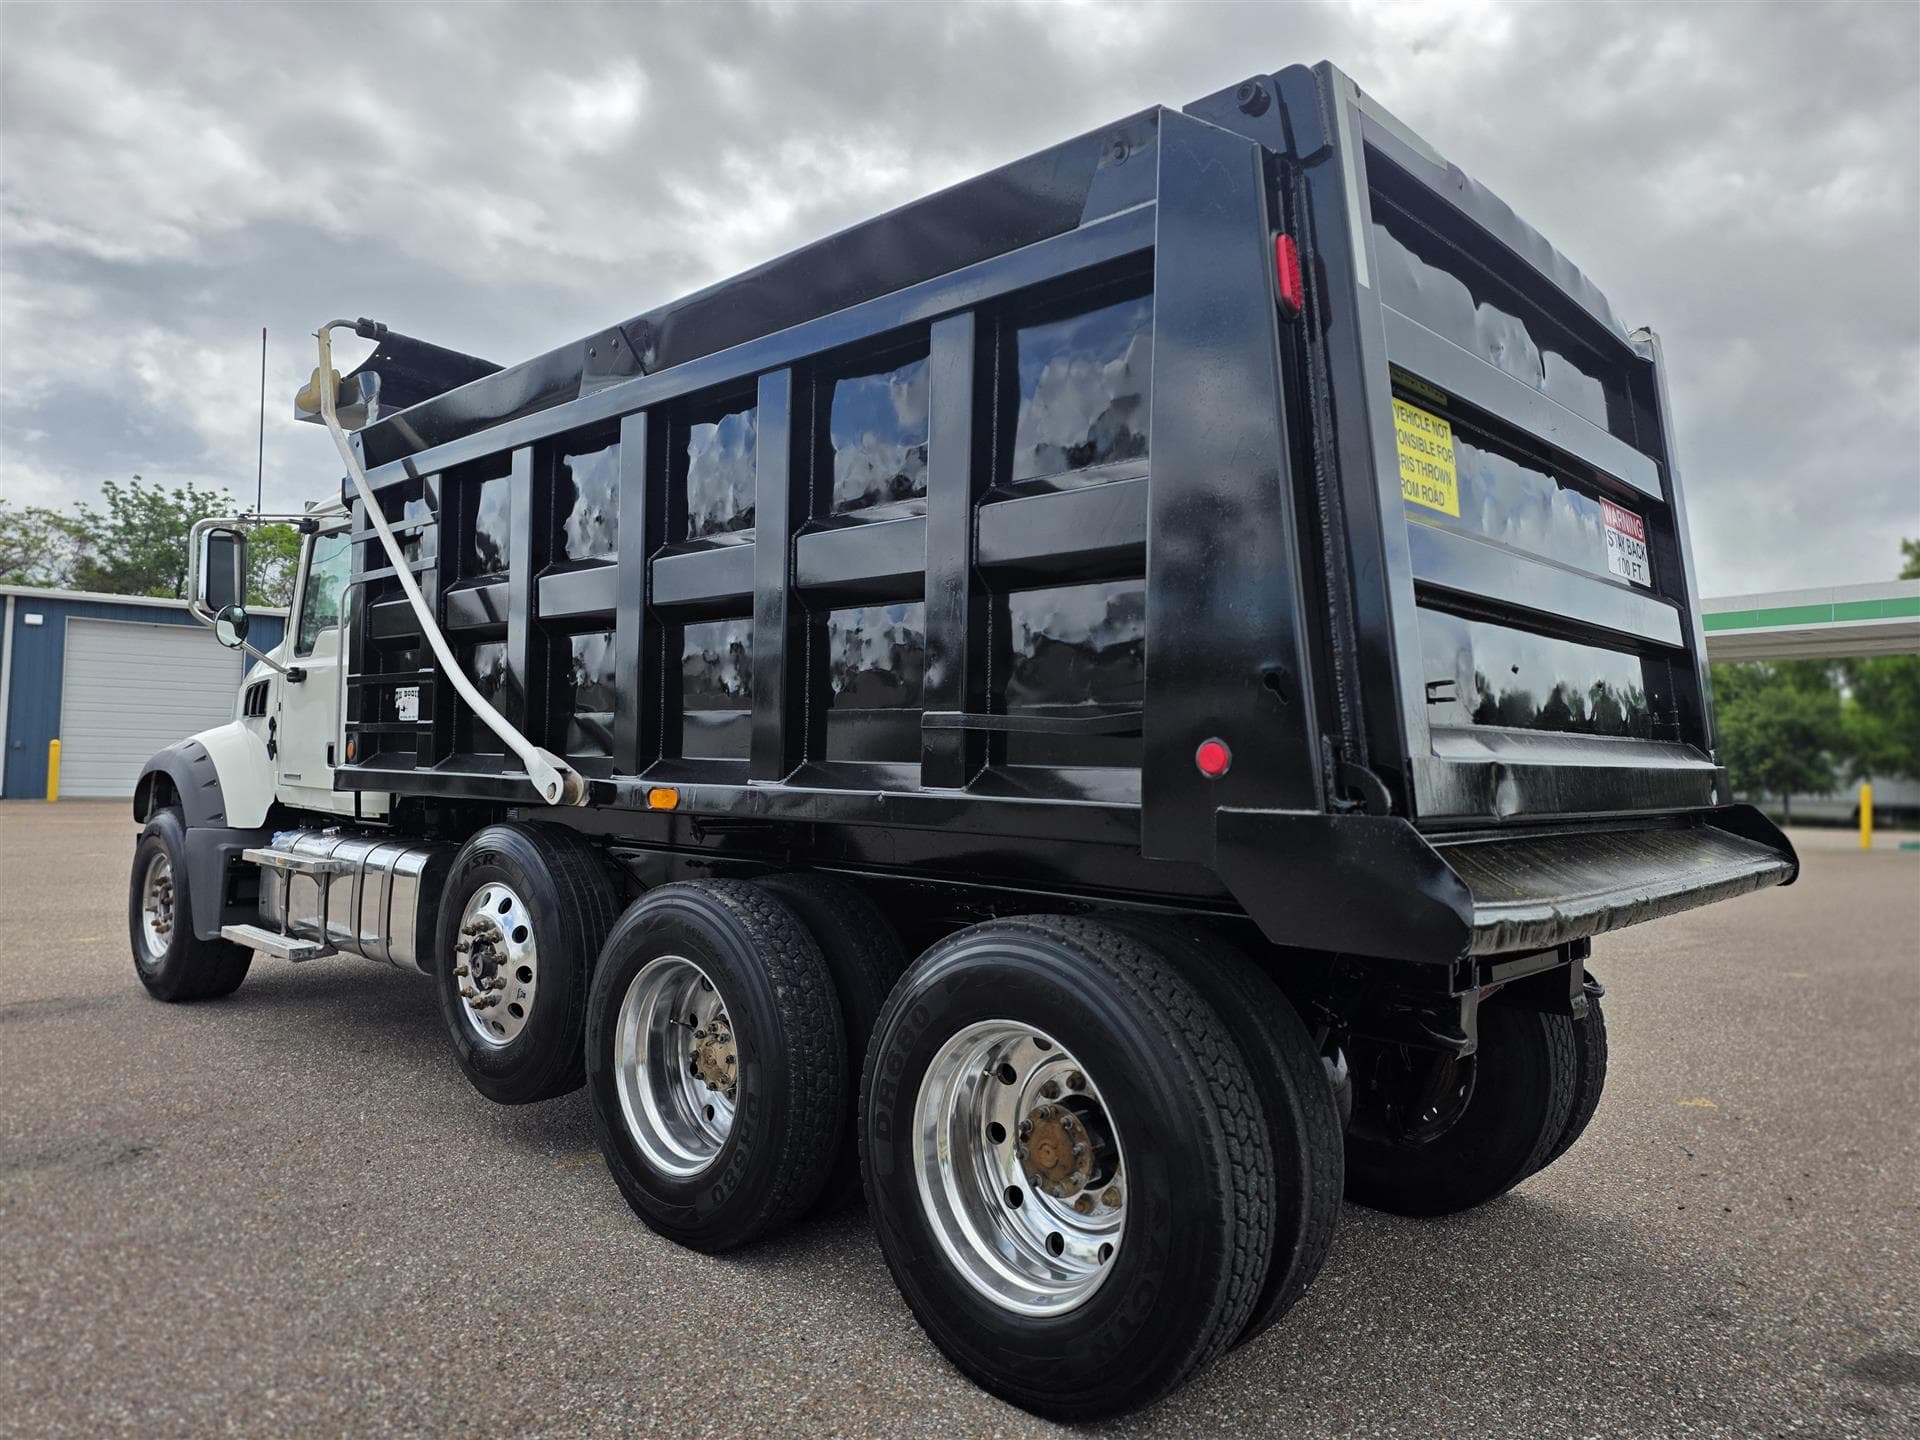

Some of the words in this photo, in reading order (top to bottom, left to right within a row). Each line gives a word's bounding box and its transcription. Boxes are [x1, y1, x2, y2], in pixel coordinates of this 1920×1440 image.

[1393, 403, 1431, 433] VEHICLE
[1432, 421, 1449, 441] NOT
[1436, 444, 1455, 465] FOR
[1415, 459, 1452, 487] THROWN
[1422, 484, 1445, 507] ROAD
[1606, 529, 1626, 553] STAY
[1626, 538, 1647, 562] BACK
[1617, 557, 1630, 576] 100
